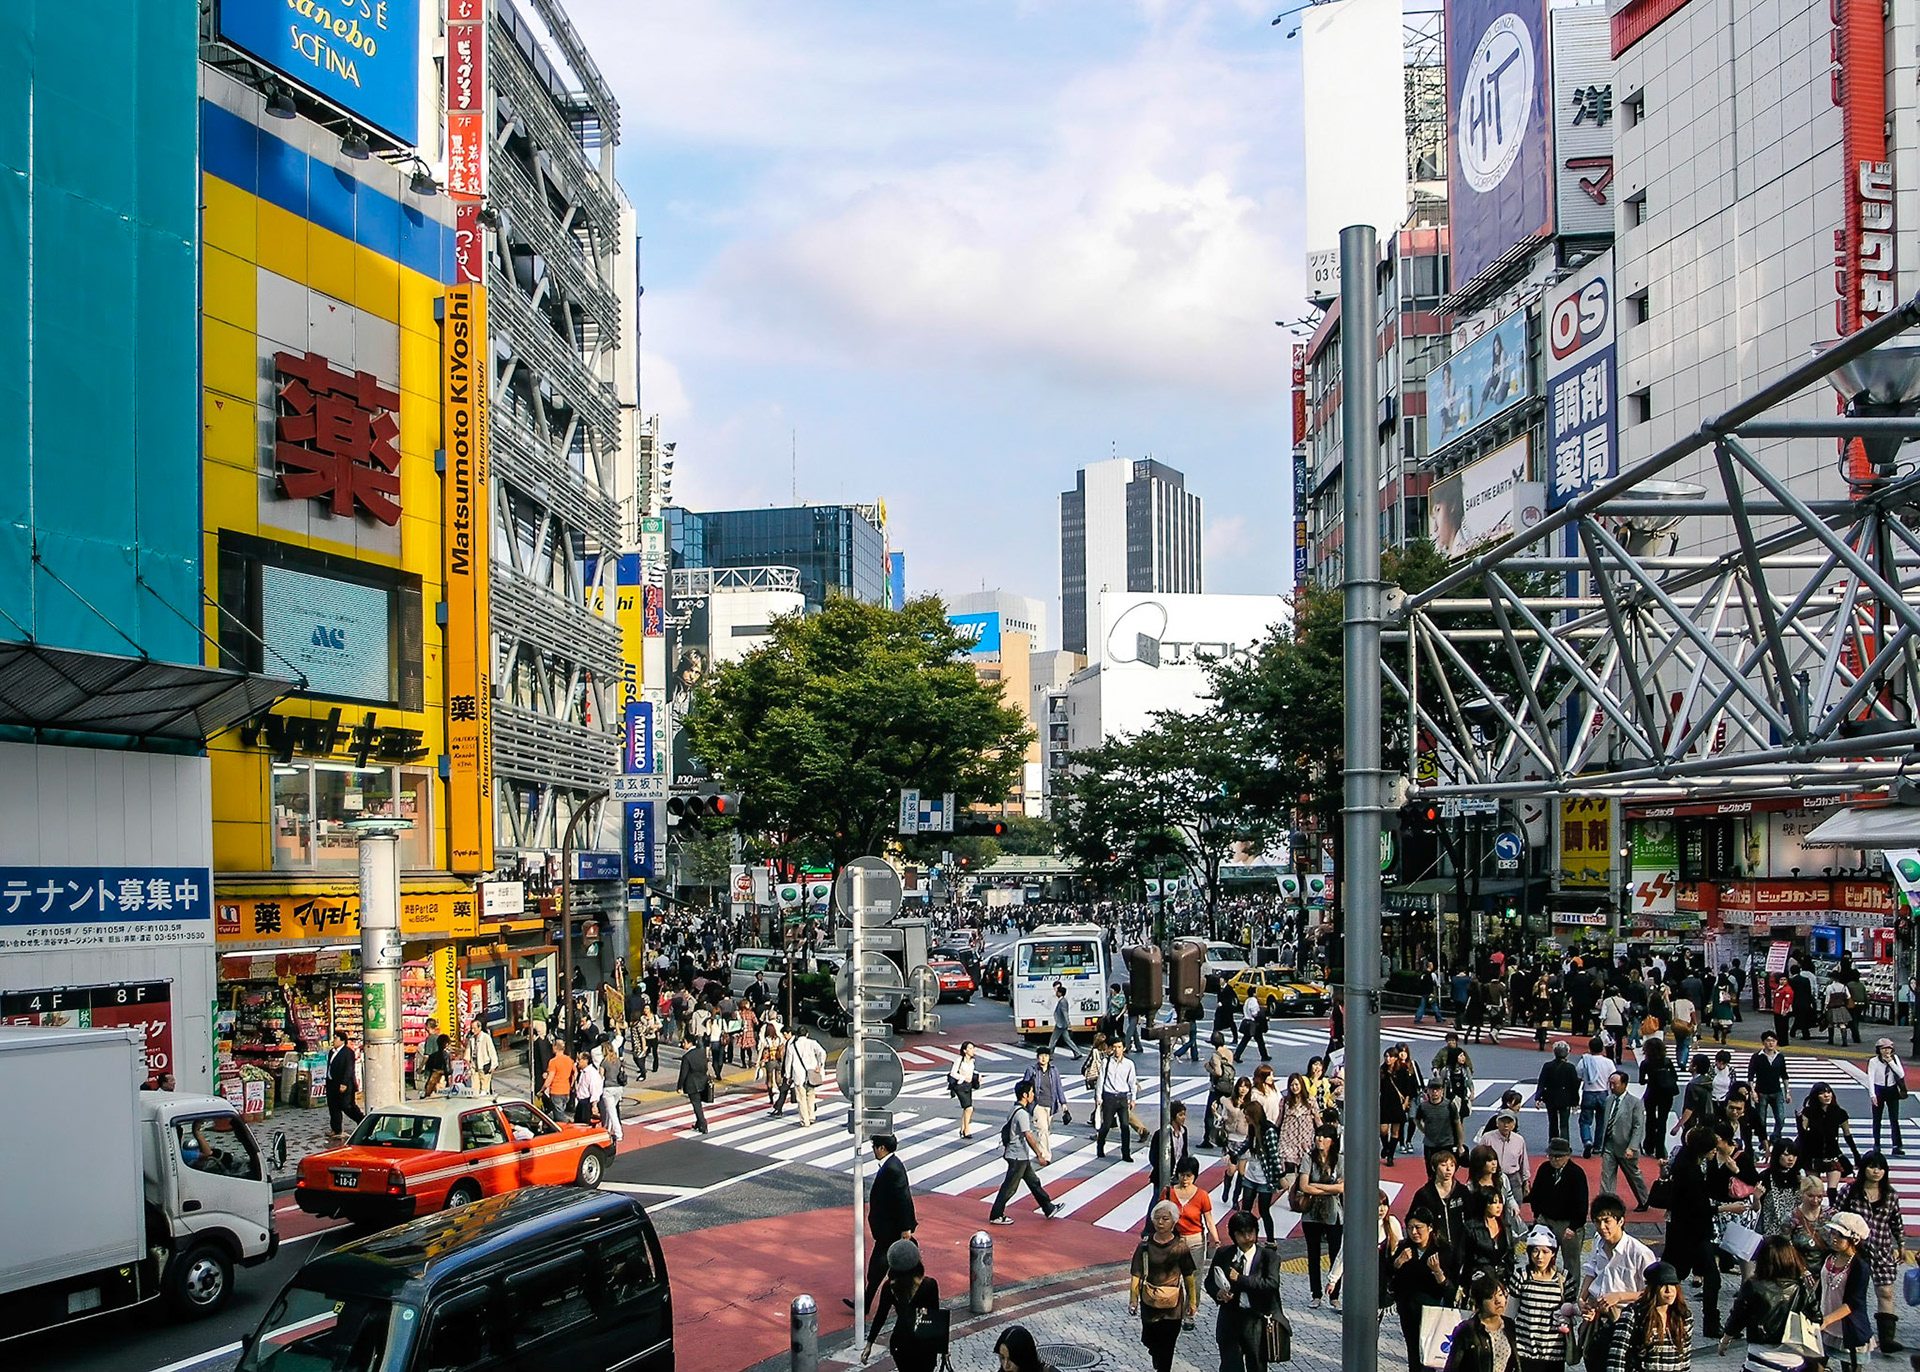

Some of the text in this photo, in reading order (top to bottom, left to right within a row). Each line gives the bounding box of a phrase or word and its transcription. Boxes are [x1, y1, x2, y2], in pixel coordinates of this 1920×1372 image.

[287, 0, 376, 57] anebo
[291, 25, 361, 88] SOFINA
[458, 117, 472, 127] 7F
[457, 206, 473, 217] 6F
[1552, 281, 1606, 351] OS
[1554, 359, 1608, 438] 調剤
[275, 351, 403, 527] 薬
[449, 291, 469, 576] Matsumoto KiYoshi
[1556, 423, 1610, 498] 薬局
[1465, 478, 1513, 511] SAVE THE EARTH
[450, 694, 476, 722] 薬
[634, 715, 646, 769] MIZUHO
[614, 778, 663, 790] 道玄坂下
[633, 808, 646, 865] みずほ銀行
[3, 878, 200, 914] テナント募集中
[254, 902, 282, 934] 薬
[453, 901, 472, 917] 薬
[1756, 889, 1830, 904] ビックカメラ
